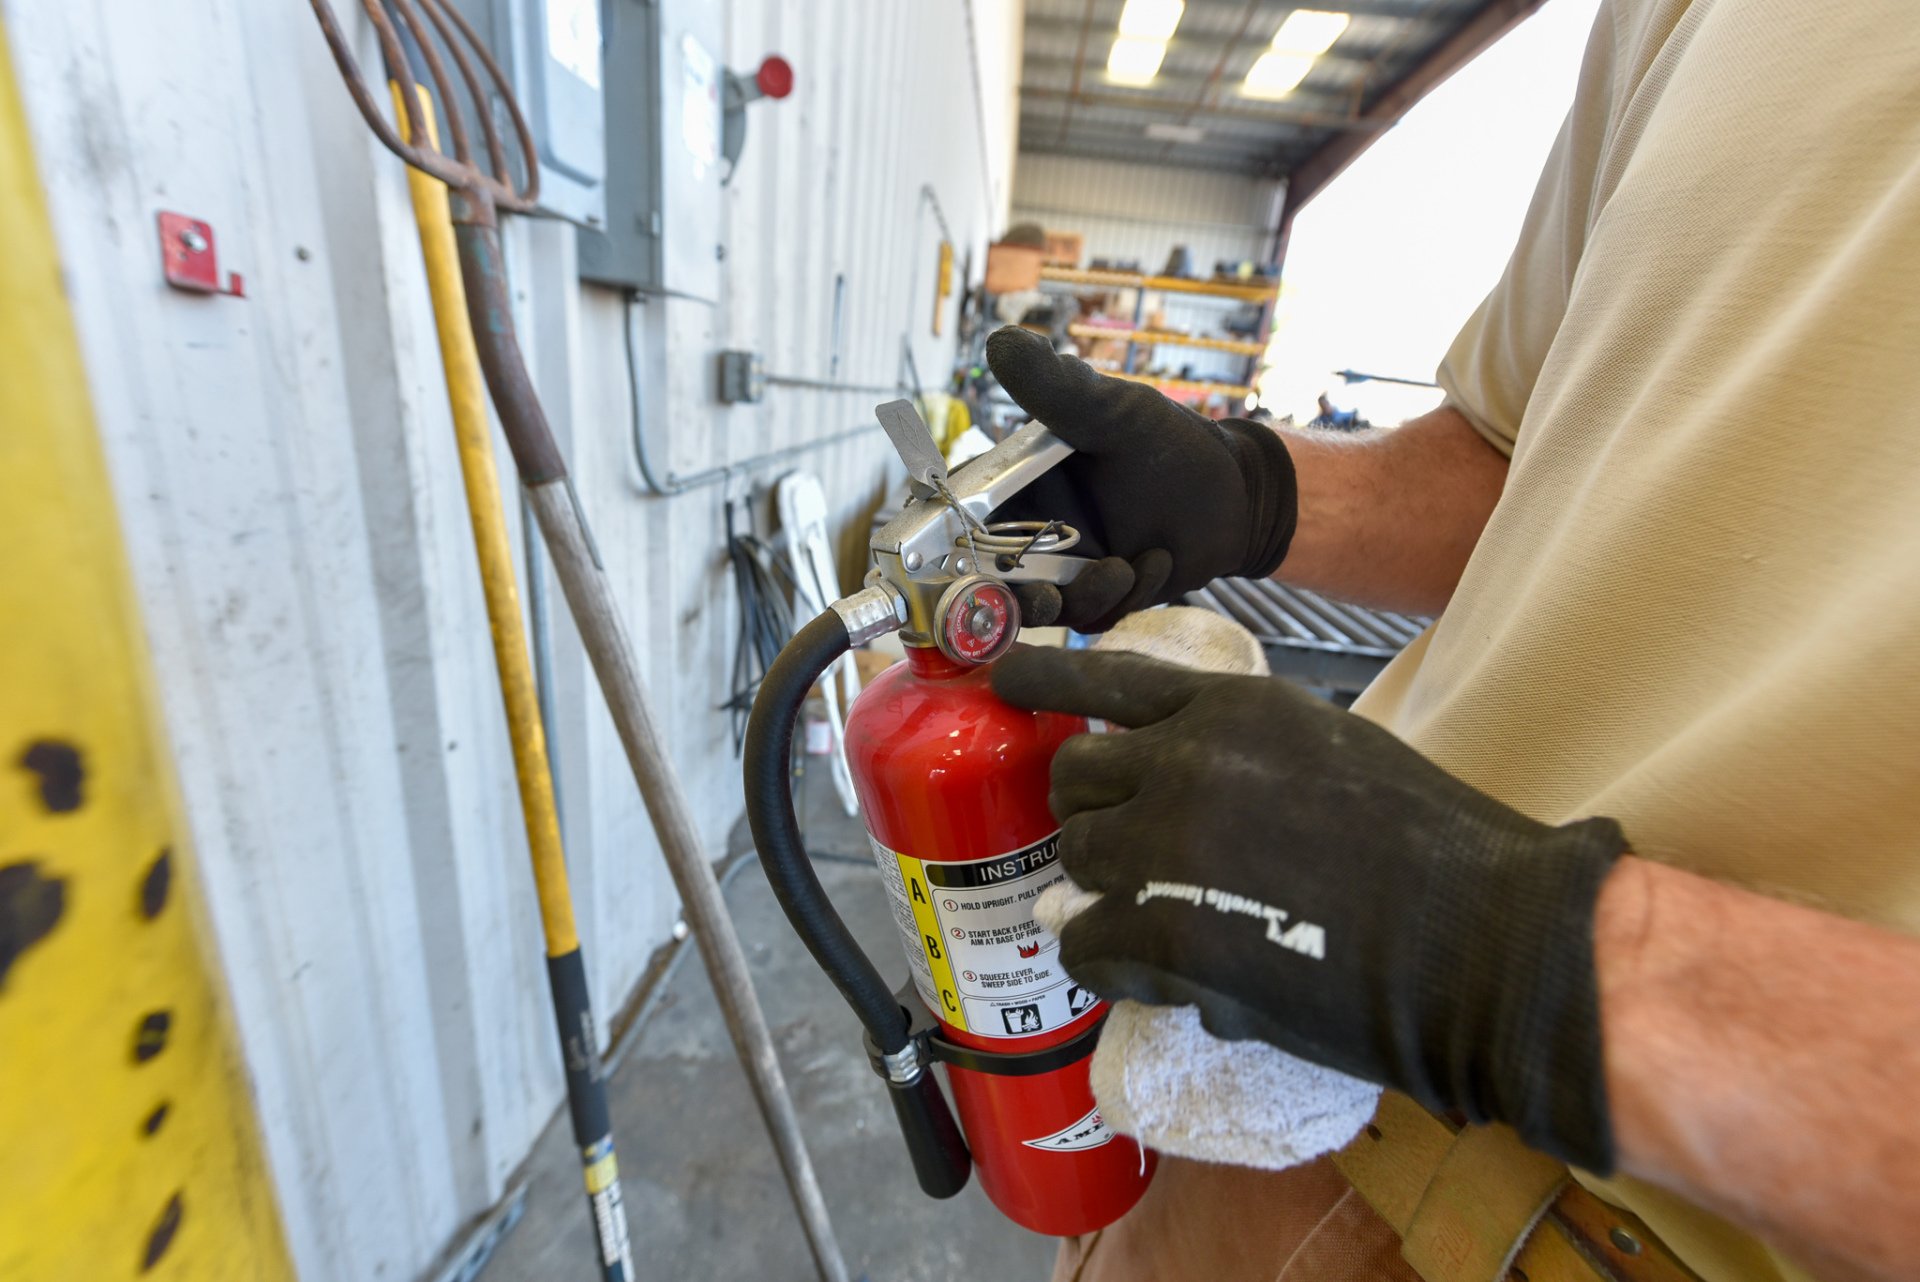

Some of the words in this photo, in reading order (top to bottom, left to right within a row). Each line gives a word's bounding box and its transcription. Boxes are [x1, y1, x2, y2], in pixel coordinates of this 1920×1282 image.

[911, 877, 926, 904] A
[961, 902, 981, 911] HOLD
[983, 895, 1017, 909] UPRIGHT.
[1018, 888, 1037, 902] PULL
[968, 929, 992, 939] START
[992, 927, 1012, 938] BACK
[1012, 925, 1018, 933] 8
[1019, 919, 1038, 932] FEET.
[970, 938, 984, 946] AIM
[985, 937, 995, 945] AT
[996, 934, 1015, 944] BASE
[1016, 931, 1025, 941] OF
[1026, 925, 1044, 938] FIRE.
[925, 934, 941, 960] B
[979, 972, 1010, 981] SQUEEZE
[1011, 967, 1036, 979] LEVER.
[981, 980, 1005, 989] SWEEP
[1006, 978, 1023, 988] SIDE
[1025, 975, 1034, 984] TO
[942, 989, 957, 1012] C
[1055, 1121, 1104, 1145] AME
